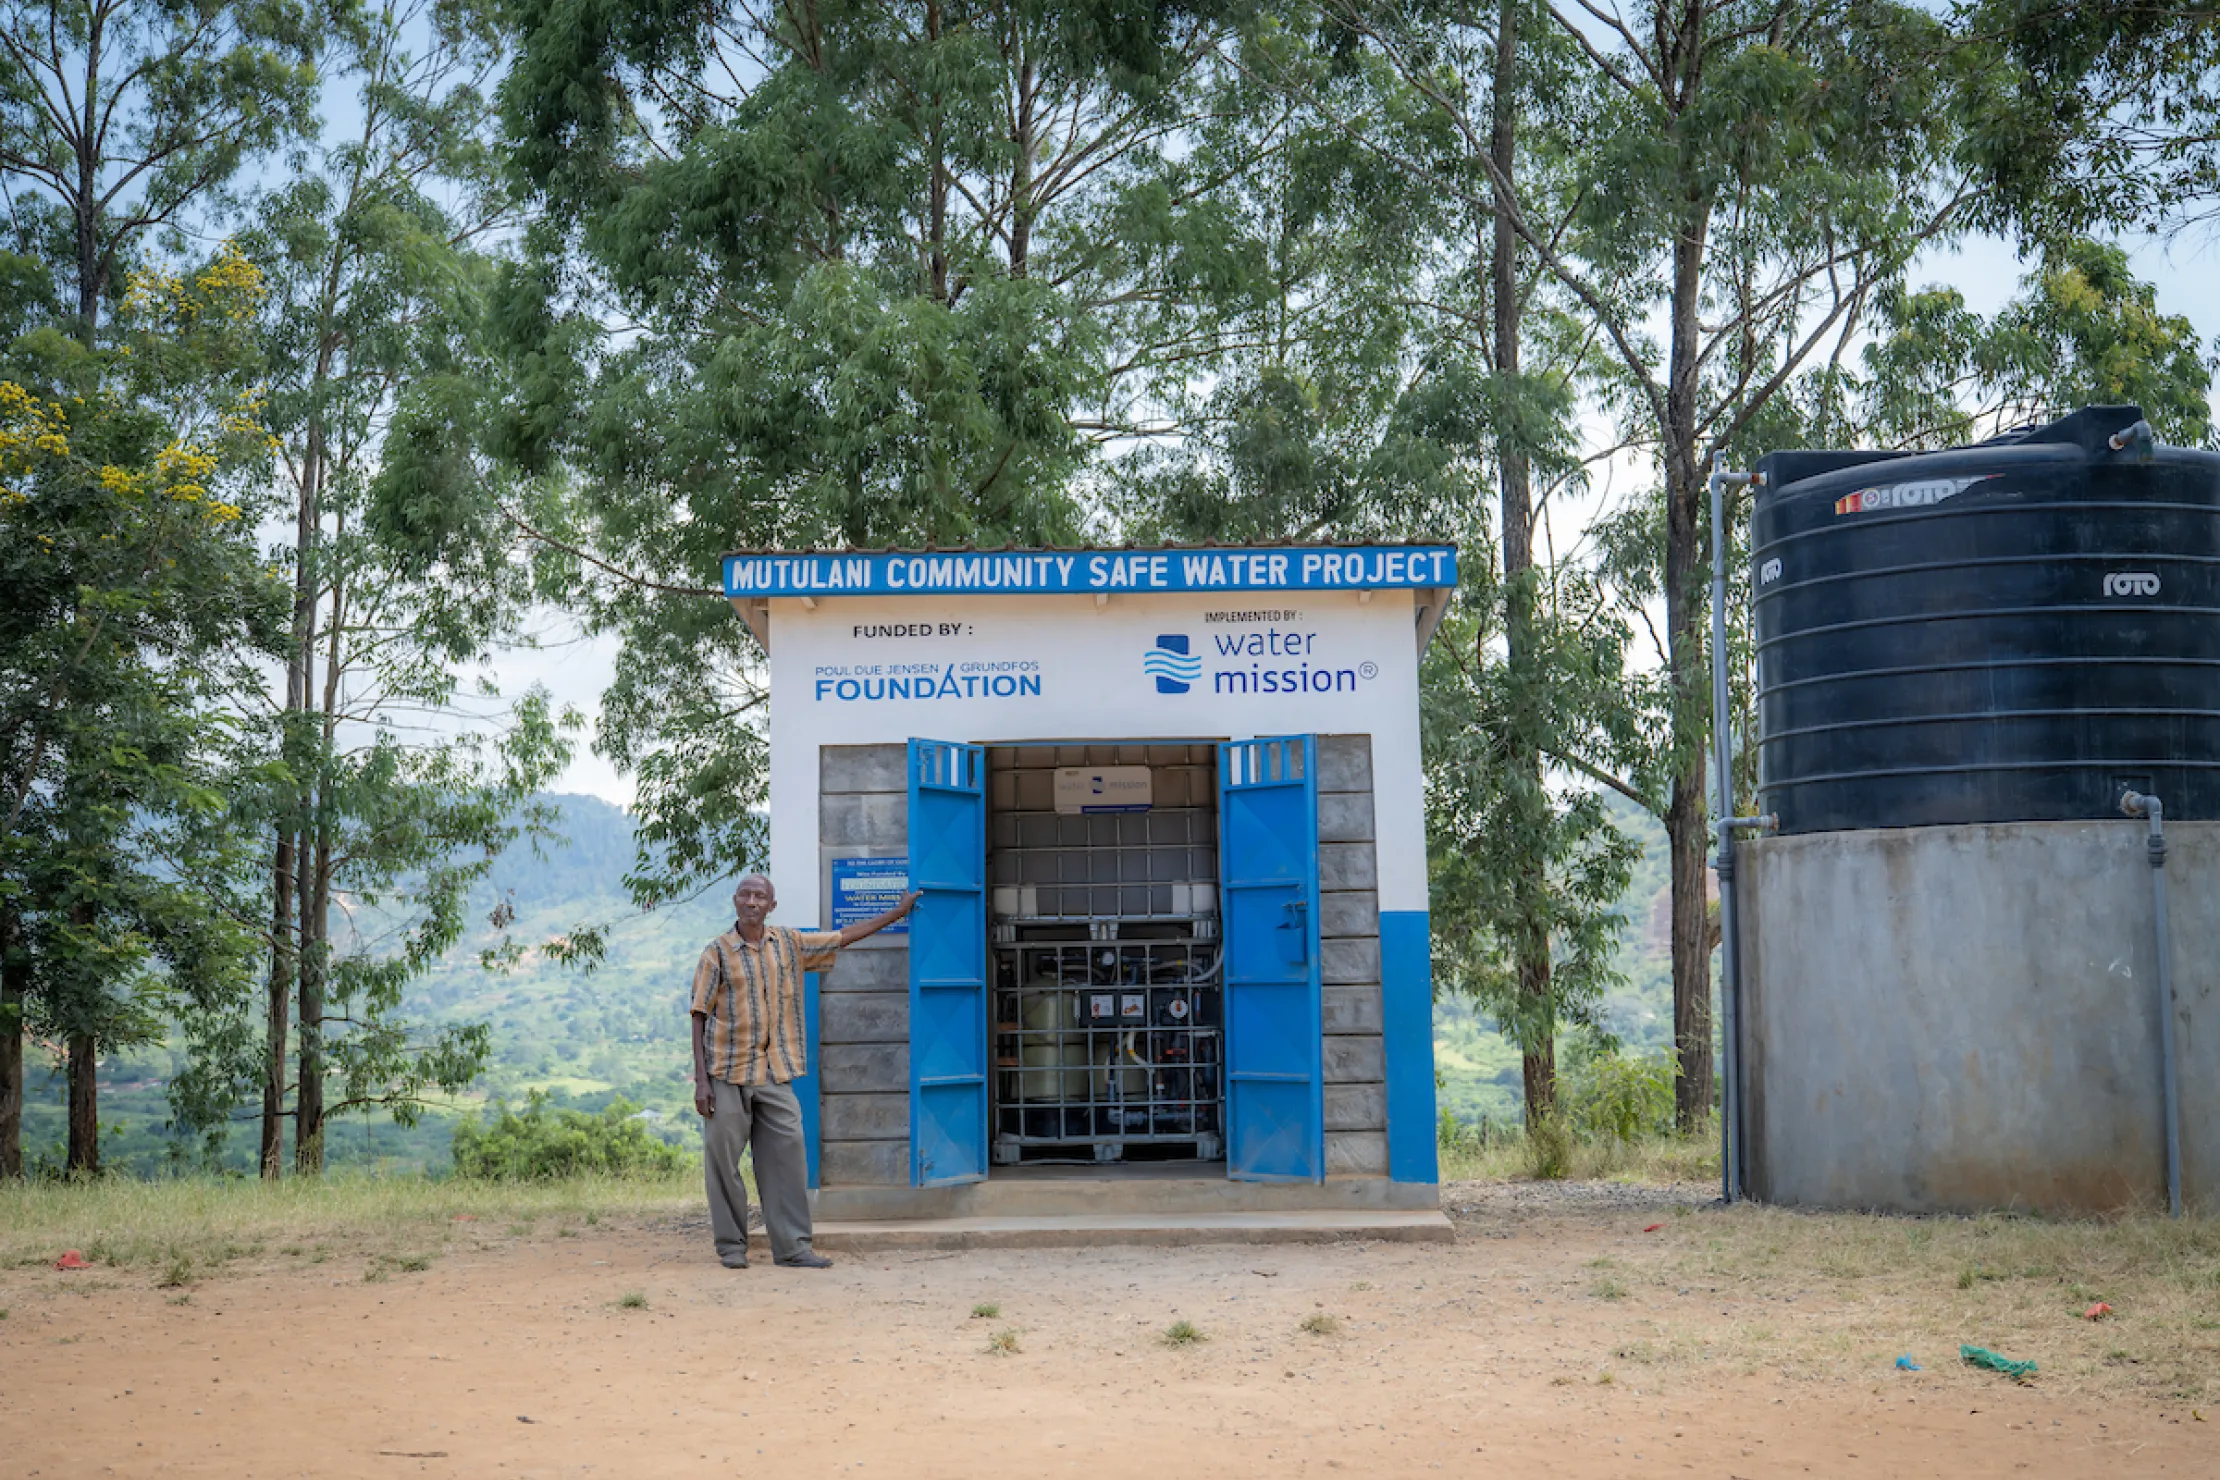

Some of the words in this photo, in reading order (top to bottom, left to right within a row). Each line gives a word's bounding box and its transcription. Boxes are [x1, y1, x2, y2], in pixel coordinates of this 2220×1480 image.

[732, 559, 871, 590] MUTULANI
[887, 556, 1074, 589] COMMUNITY
[1089, 556, 1168, 587] SAFE
[1182, 554, 1288, 587] WATER
[1302, 551, 1448, 584] PROJECT
[1205, 609, 1281, 624] IMPLEMENTED
[853, 623, 933, 639] FUNDED
[1214, 627, 1317, 657] water
[815, 666, 851, 677] POUL
[854, 664, 882, 676] DUE
[887, 663, 939, 676] JENSEN
[959, 660, 1040, 674] GRUNDFOS
[815, 663, 1042, 702] FOUNDATION
